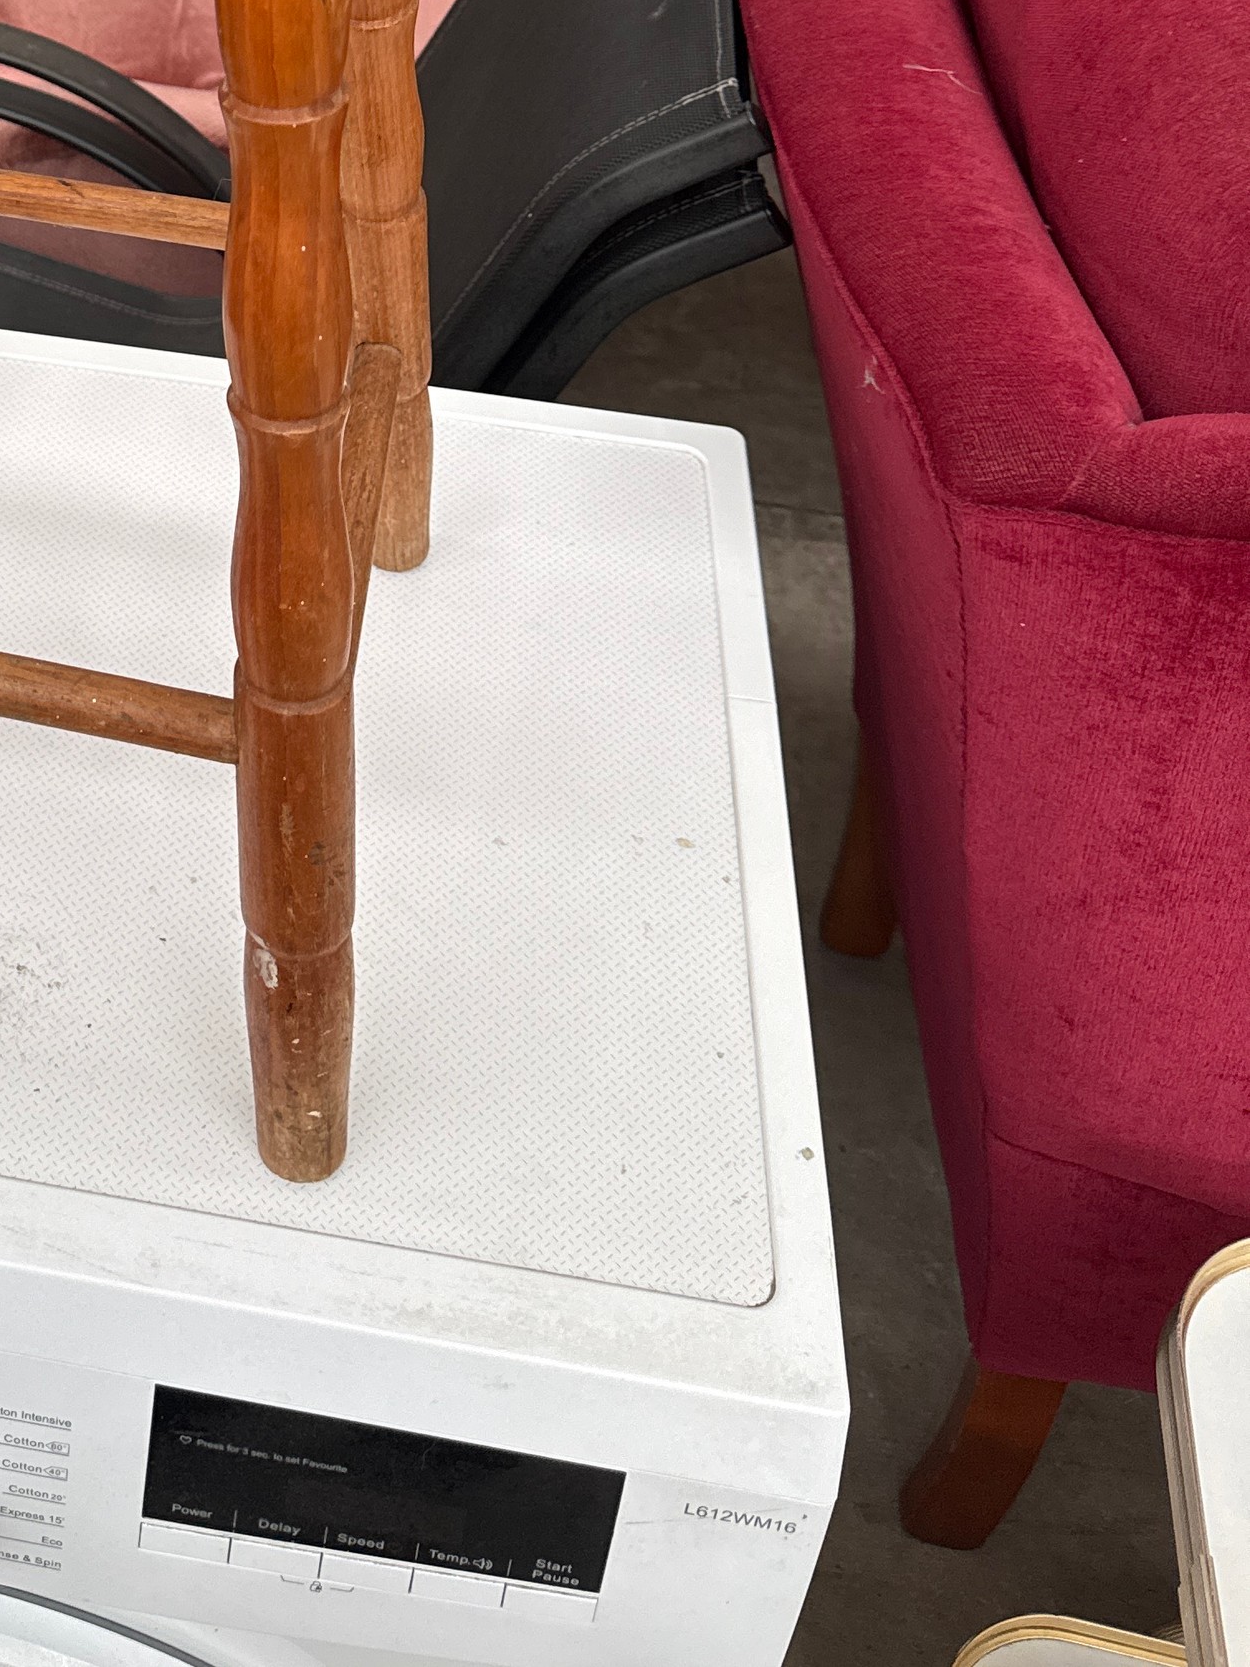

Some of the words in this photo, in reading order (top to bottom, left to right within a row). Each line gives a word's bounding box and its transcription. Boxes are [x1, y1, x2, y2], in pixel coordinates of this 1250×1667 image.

[21, 1410, 72, 1428] Intensive
[3, 1434, 45, 1449] Cotton
[196, 1438, 225, 1452] Press
[226, 1444, 240, 1454] for
[242, 1447, 249, 1456] 3
[273, 1453, 283, 1462] to
[285, 1456, 301, 1465] set
[302, 1458, 348, 1473] Favourite
[1, 1459, 42, 1474] Cotton
[8, 1484, 49, 1499] Cotton
[0, 1505, 45, 1521] Express
[171, 1503, 213, 1519] Power
[683, 1502, 797, 1534] L612WM16
[257, 1518, 301, 1536] Delay
[41, 1536, 63, 1547] Eco
[337, 1533, 385, 1551] Speed
[22, 1554, 31, 1562] &
[34, 1556, 62, 1569] Spin
[429, 1548, 471, 1566] Temp.
[535, 1558, 573, 1574] Start
[532, 1569, 580, 1586] Pause
